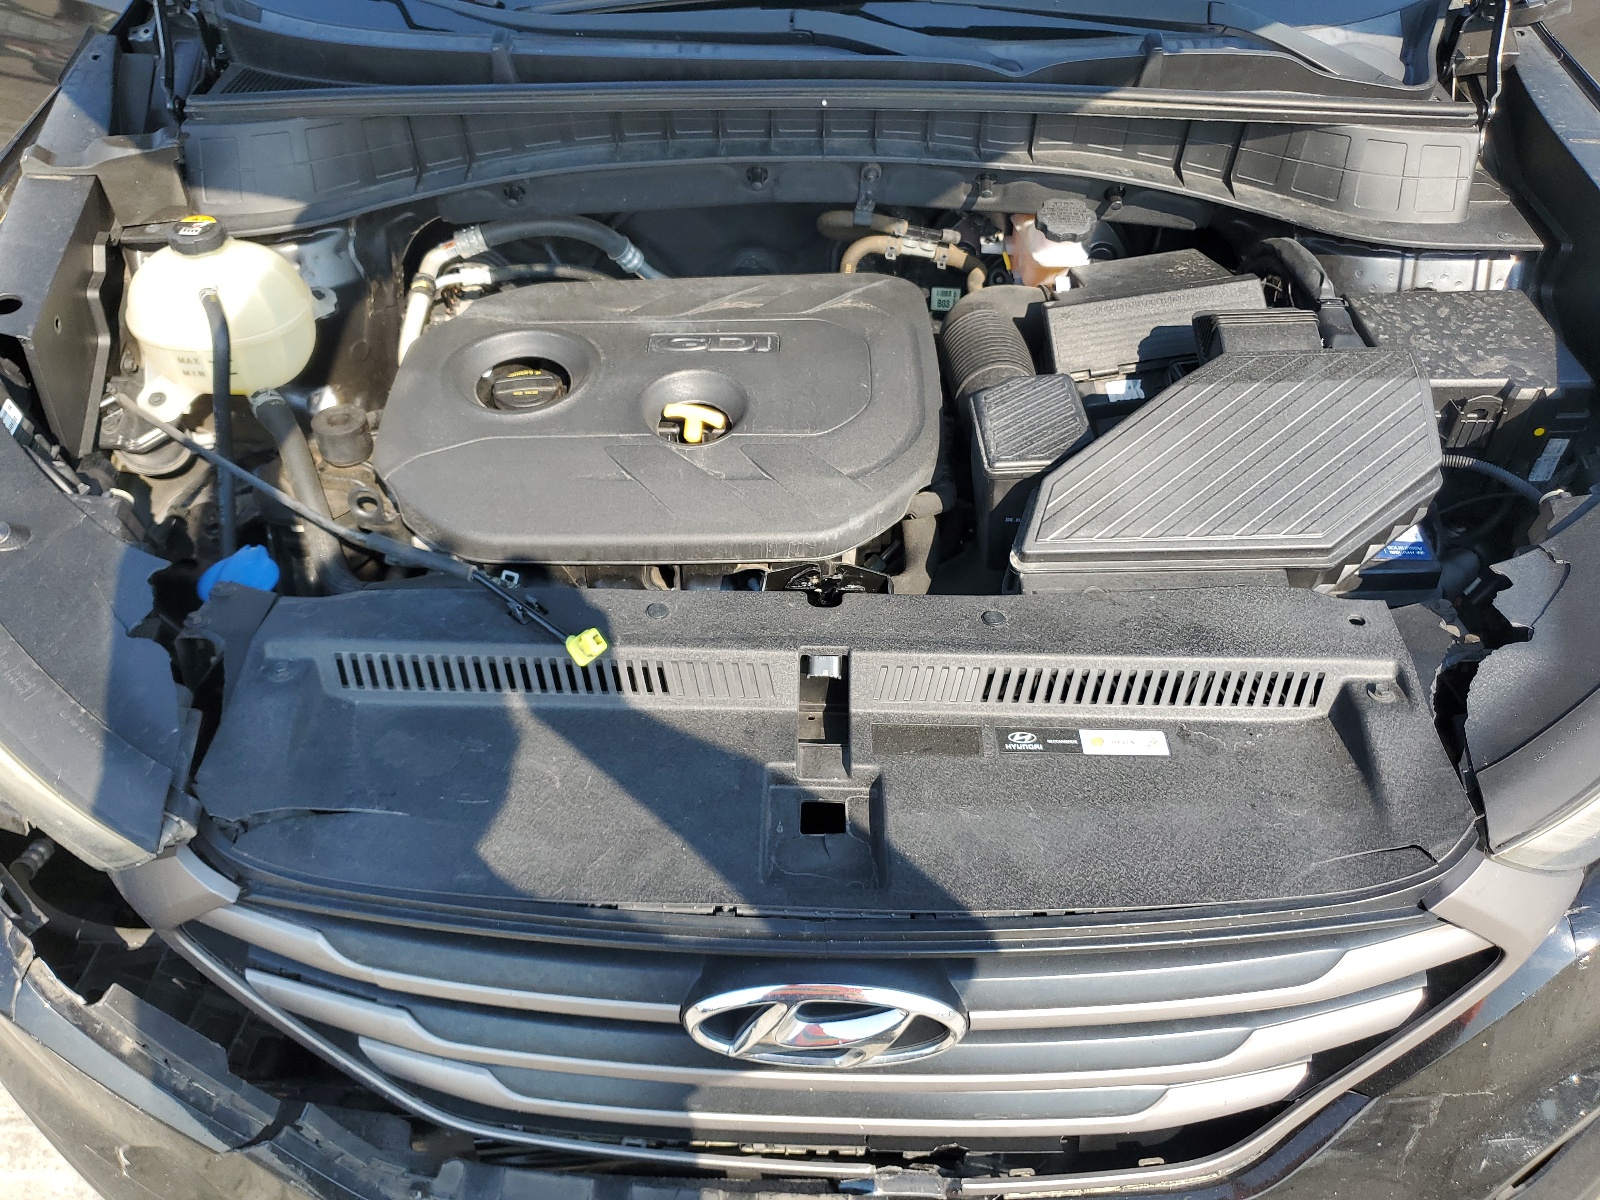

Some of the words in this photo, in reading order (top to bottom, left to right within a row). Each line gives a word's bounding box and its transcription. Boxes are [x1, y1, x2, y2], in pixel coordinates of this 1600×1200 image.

[658, 337, 772, 352] GDI
[177, 356, 200, 365] MAX
[182, 369, 206, 377] MIN
[1004, 743, 1043, 751] HYUNDAI
